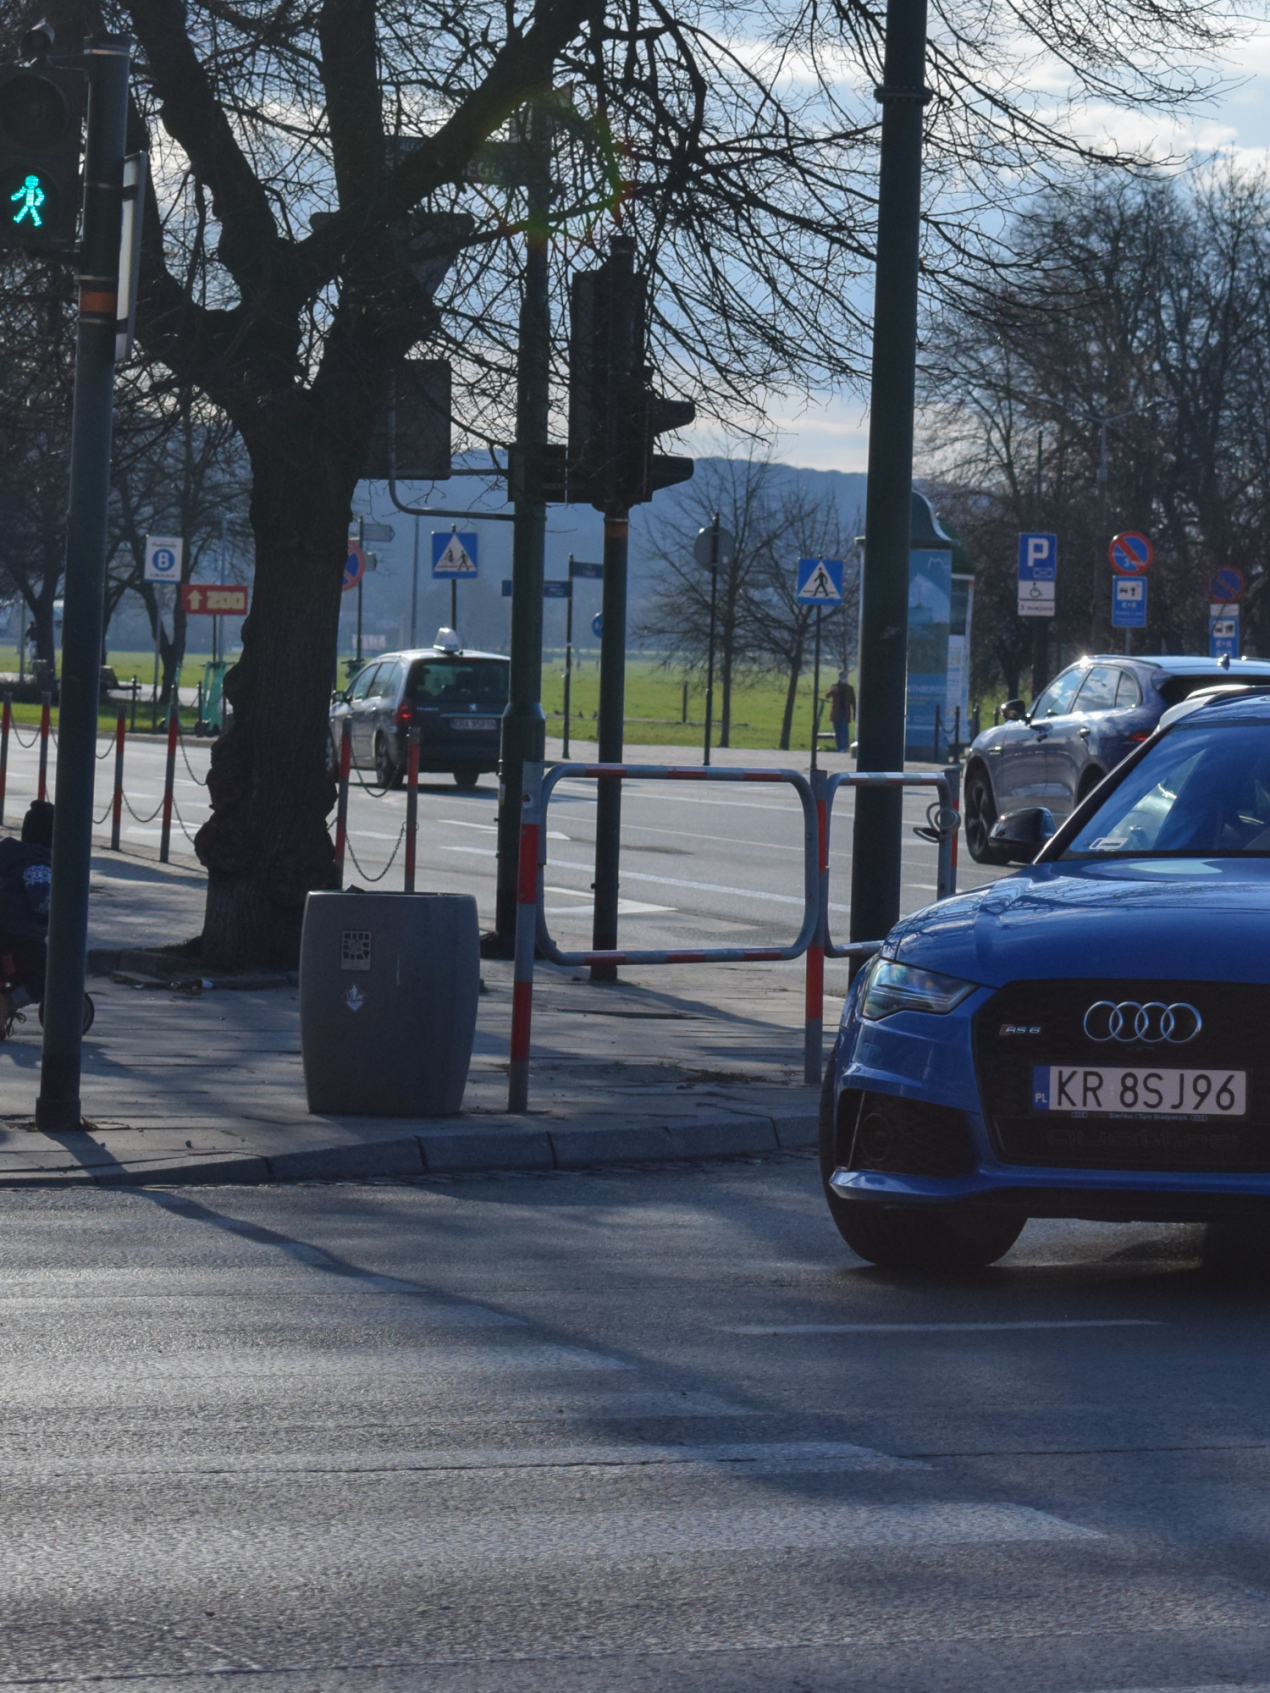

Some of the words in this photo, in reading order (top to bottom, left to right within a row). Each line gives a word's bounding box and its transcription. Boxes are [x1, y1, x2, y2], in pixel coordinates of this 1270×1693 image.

[1027, 537, 1049, 567] P
[1035, 1092, 1048, 1103] PL
[1057, 1069, 1104, 1107] KR
[1119, 1071, 1235, 1111] 8SJ96
